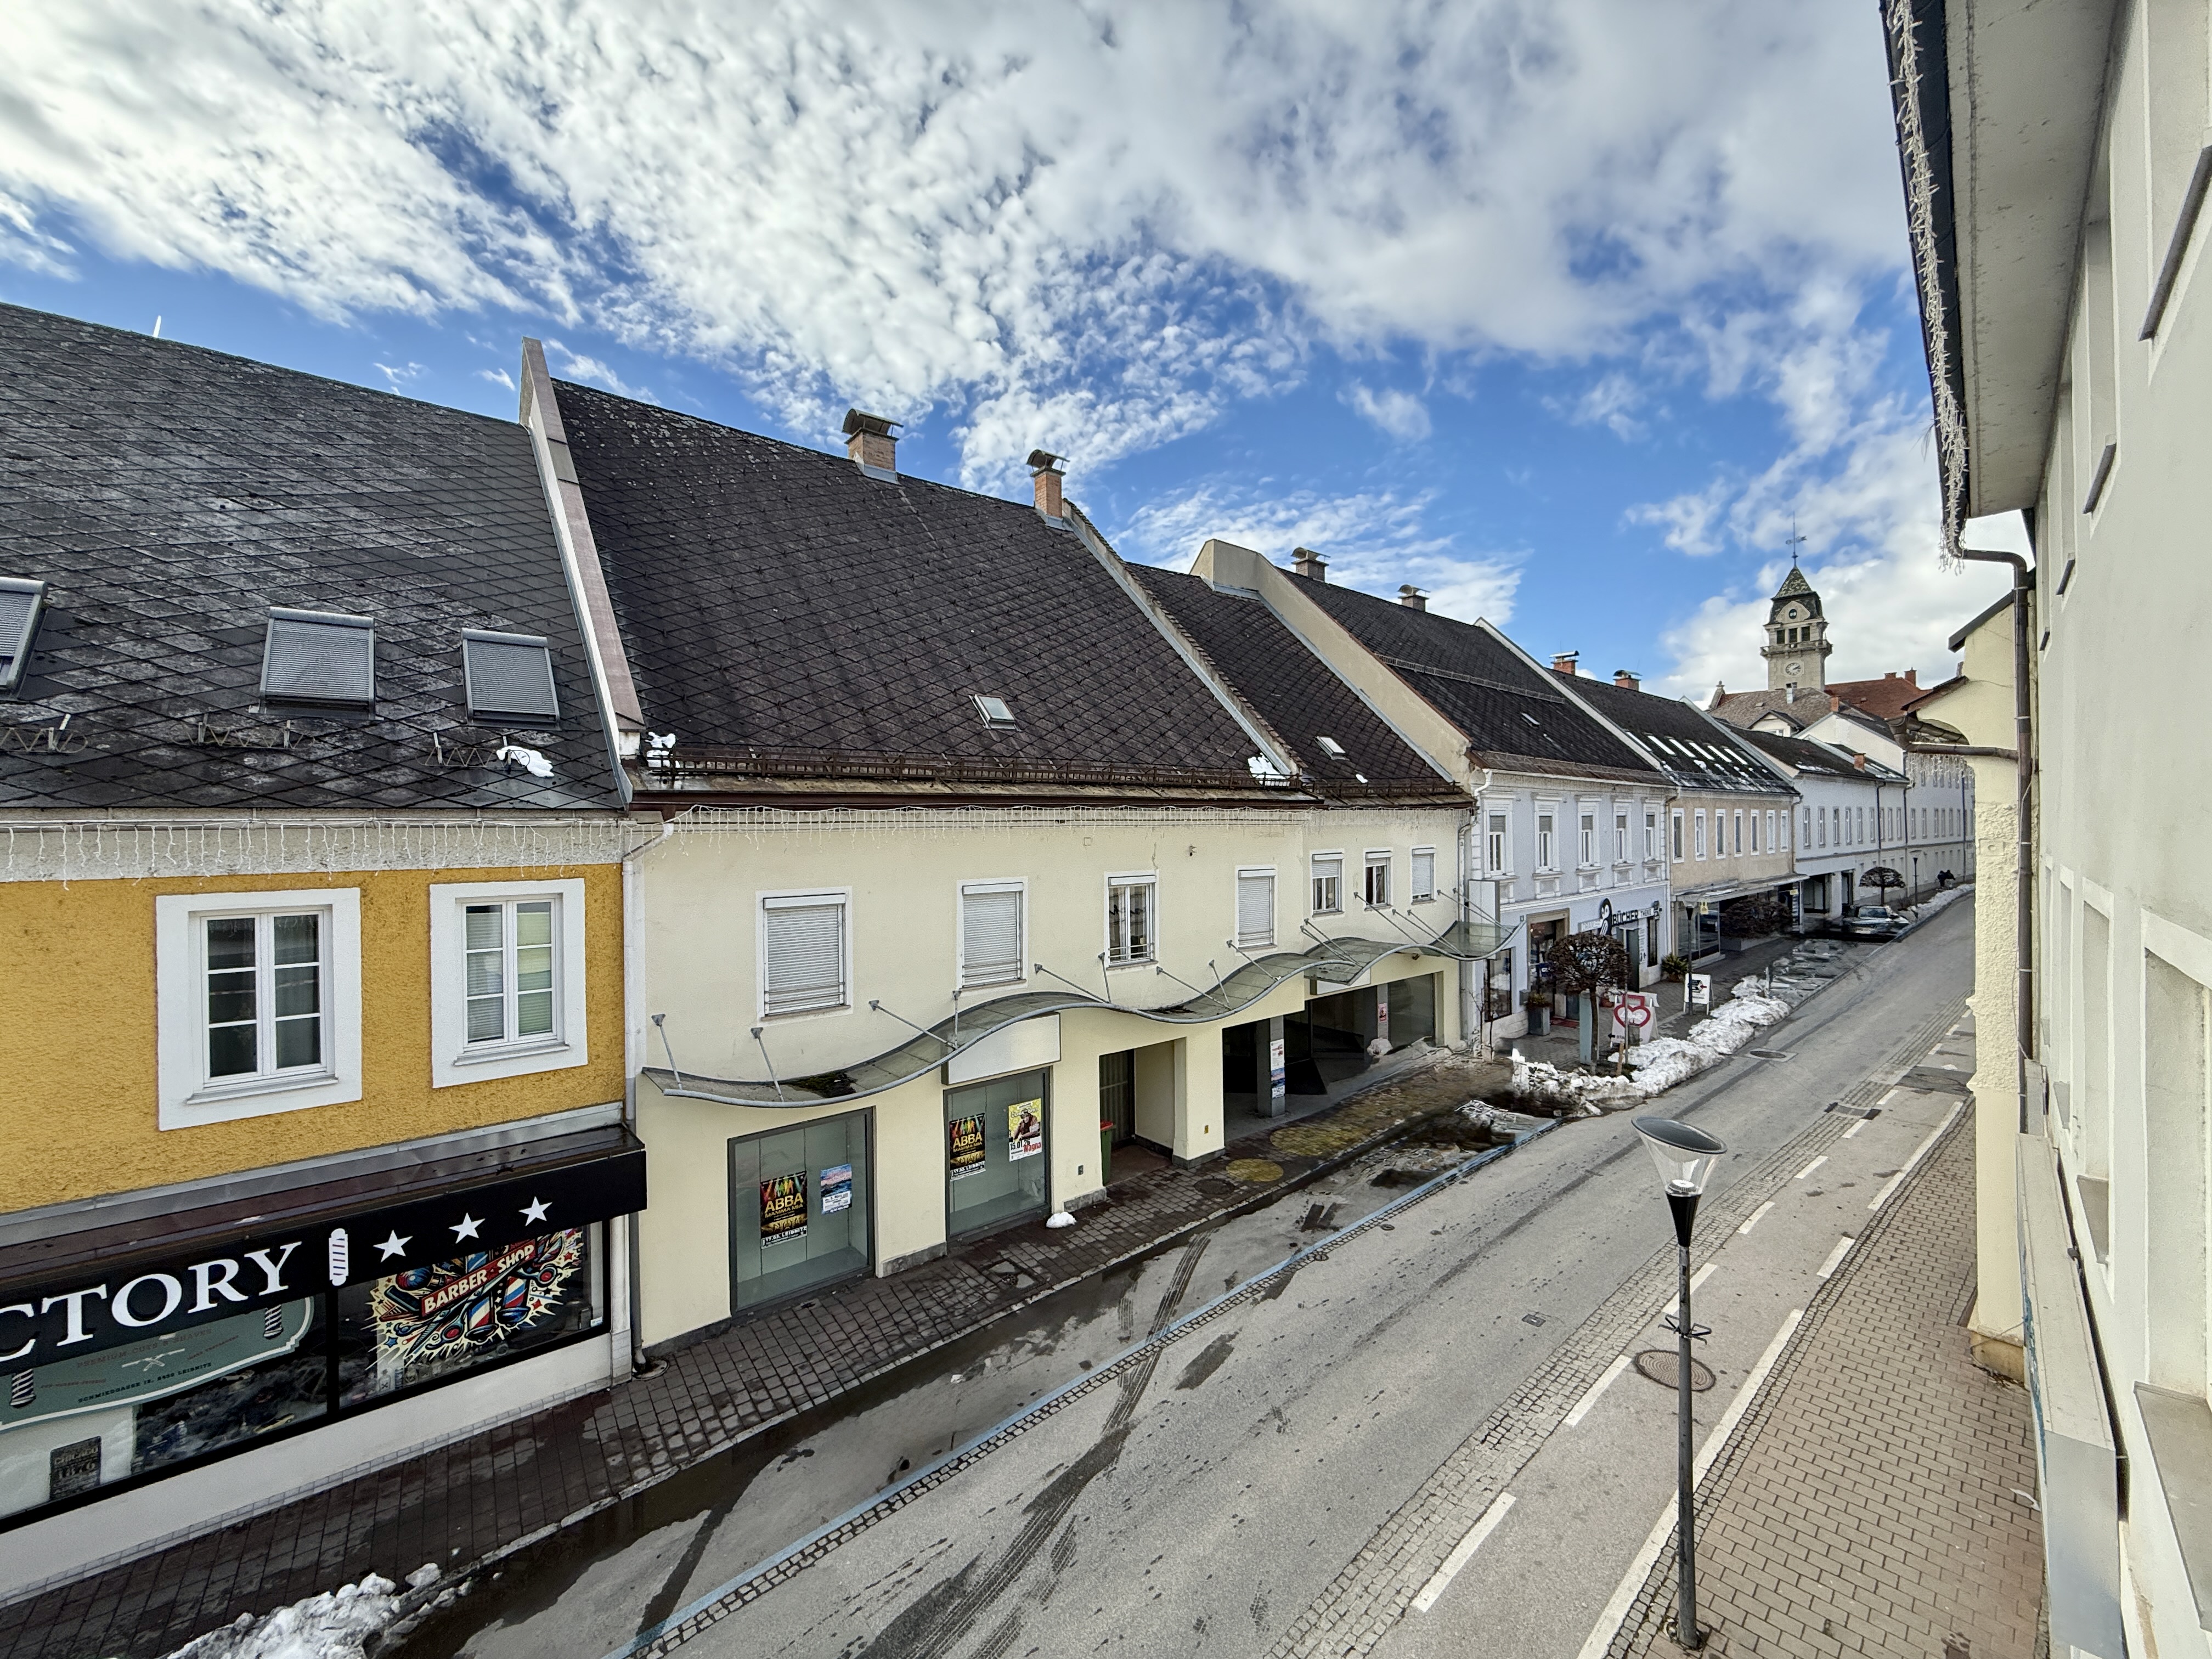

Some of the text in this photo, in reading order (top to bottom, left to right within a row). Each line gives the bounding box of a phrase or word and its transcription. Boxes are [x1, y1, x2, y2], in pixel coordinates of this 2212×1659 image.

[1612, 910, 1639, 925] BÜCHER
[953, 1132, 983, 1148] ABBA
[1023, 1142, 1041, 1153] Wagna
[765, 1193, 804, 1213] ABBA
[765, 1207, 791, 1218] MAMMA
[425, 1245, 534, 1313] BARBER SHOP
